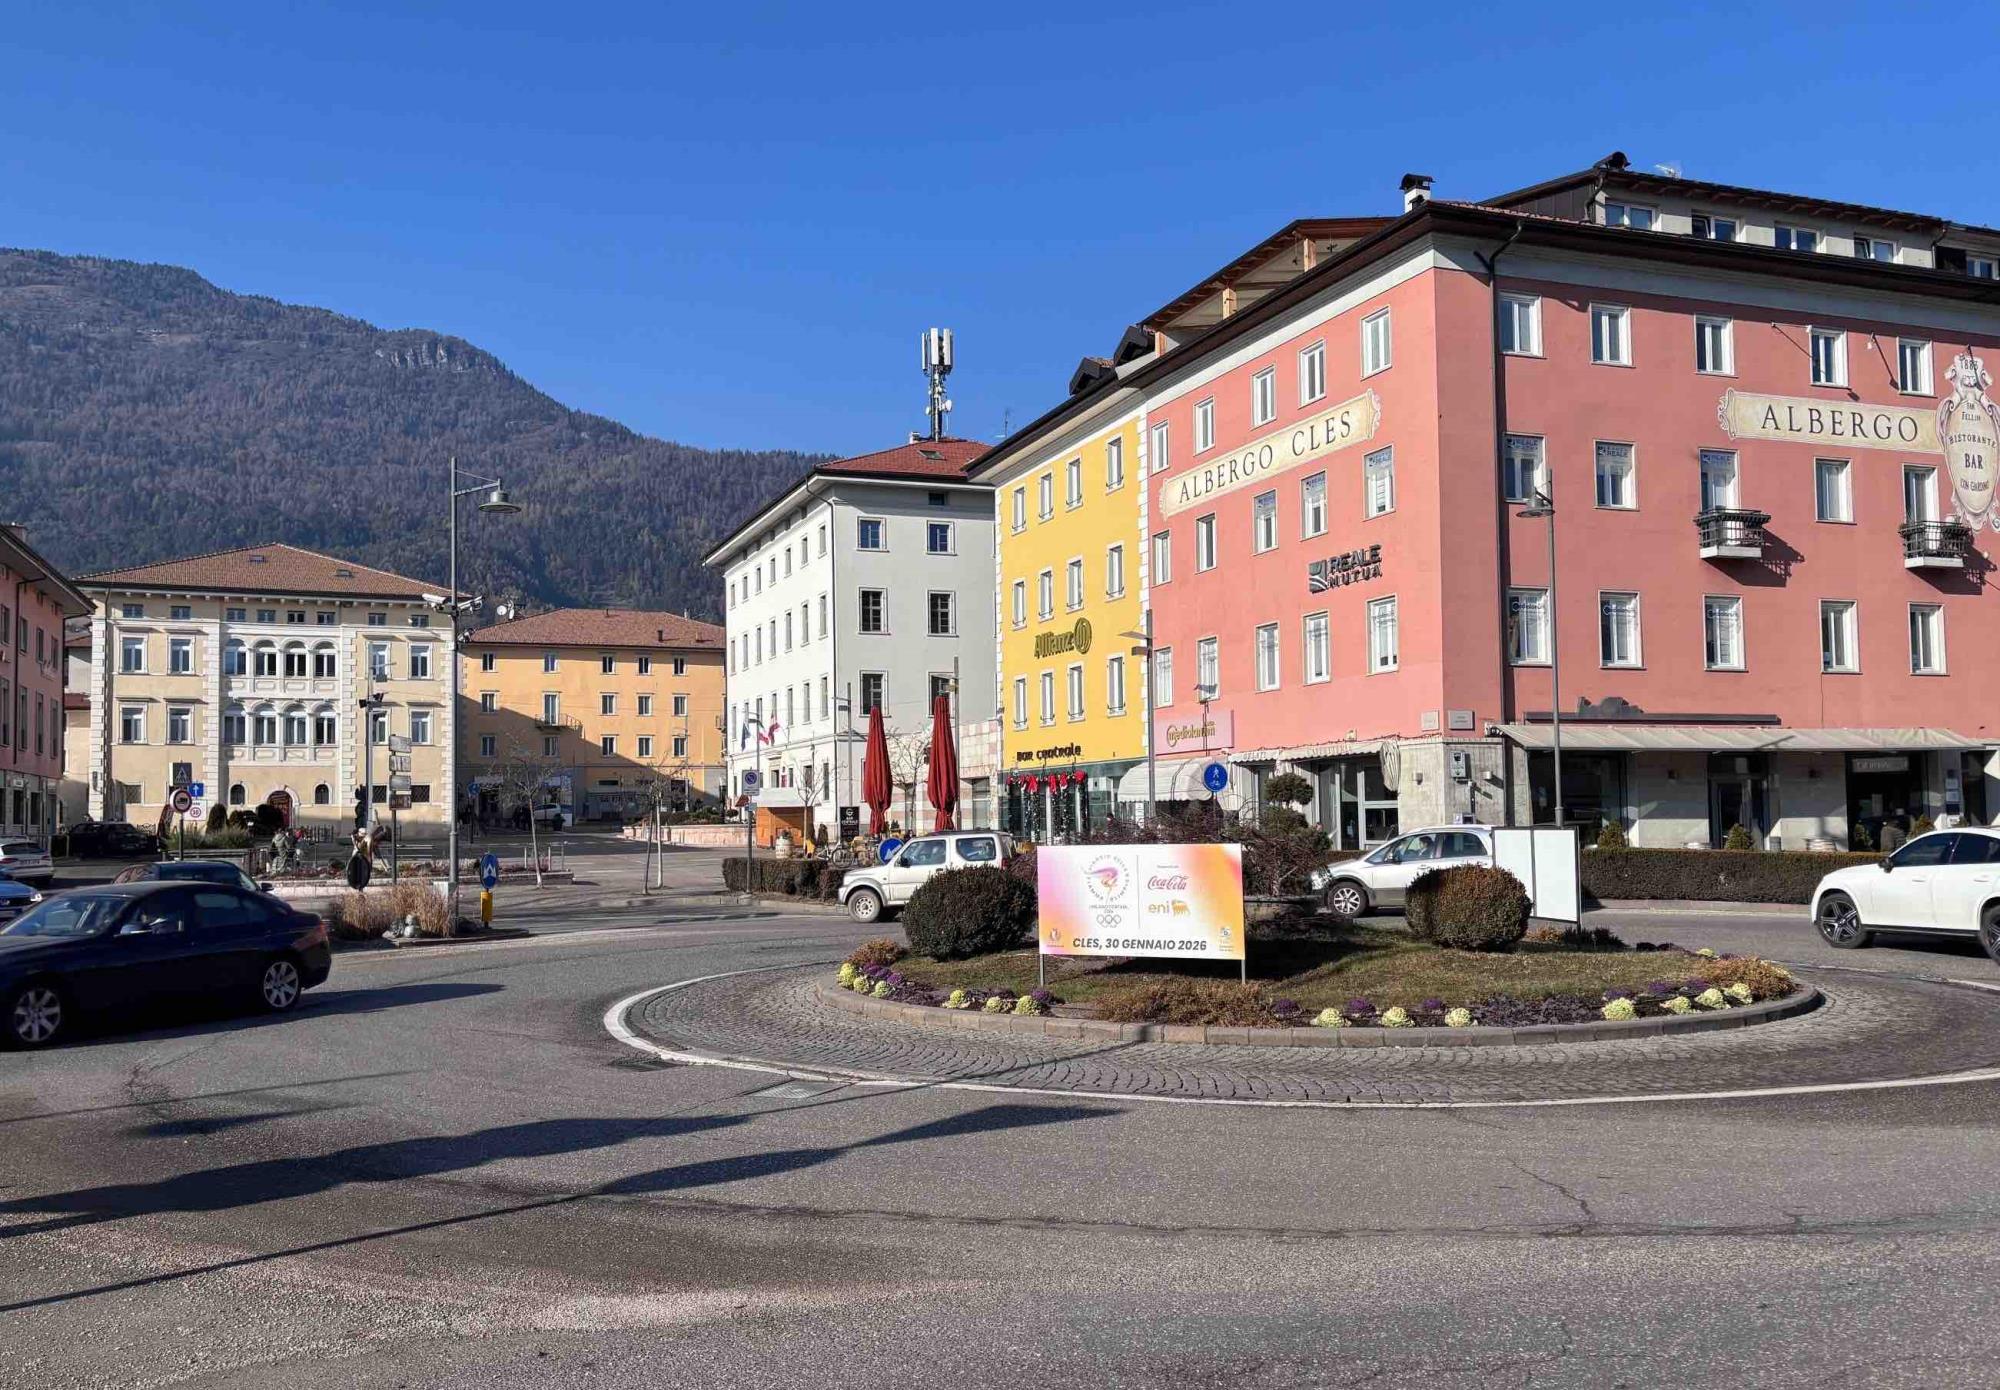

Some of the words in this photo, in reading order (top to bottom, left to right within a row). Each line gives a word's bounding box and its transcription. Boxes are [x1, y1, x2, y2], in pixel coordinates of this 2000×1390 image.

[1761, 404, 1919, 442] ALBERGO
[1948, 434, 1997, 448] RISTORANTE
[1179, 444, 1273, 503] ALBERGO
[1291, 410, 1351, 457] CLES
[1964, 453, 1984, 470] BAR
[1328, 544, 1383, 575] REALE
[1328, 564, 1383, 588] MUTUA
[1034, 631, 1075, 659] Allianz
[1148, 901, 1169, 914] eni
[1072, 937, 1102, 950] CLES,
[1105, 938, 1119, 949] 30
[1122, 938, 1177, 951] GENNAIO
[1178, 939, 1207, 951] 2026
